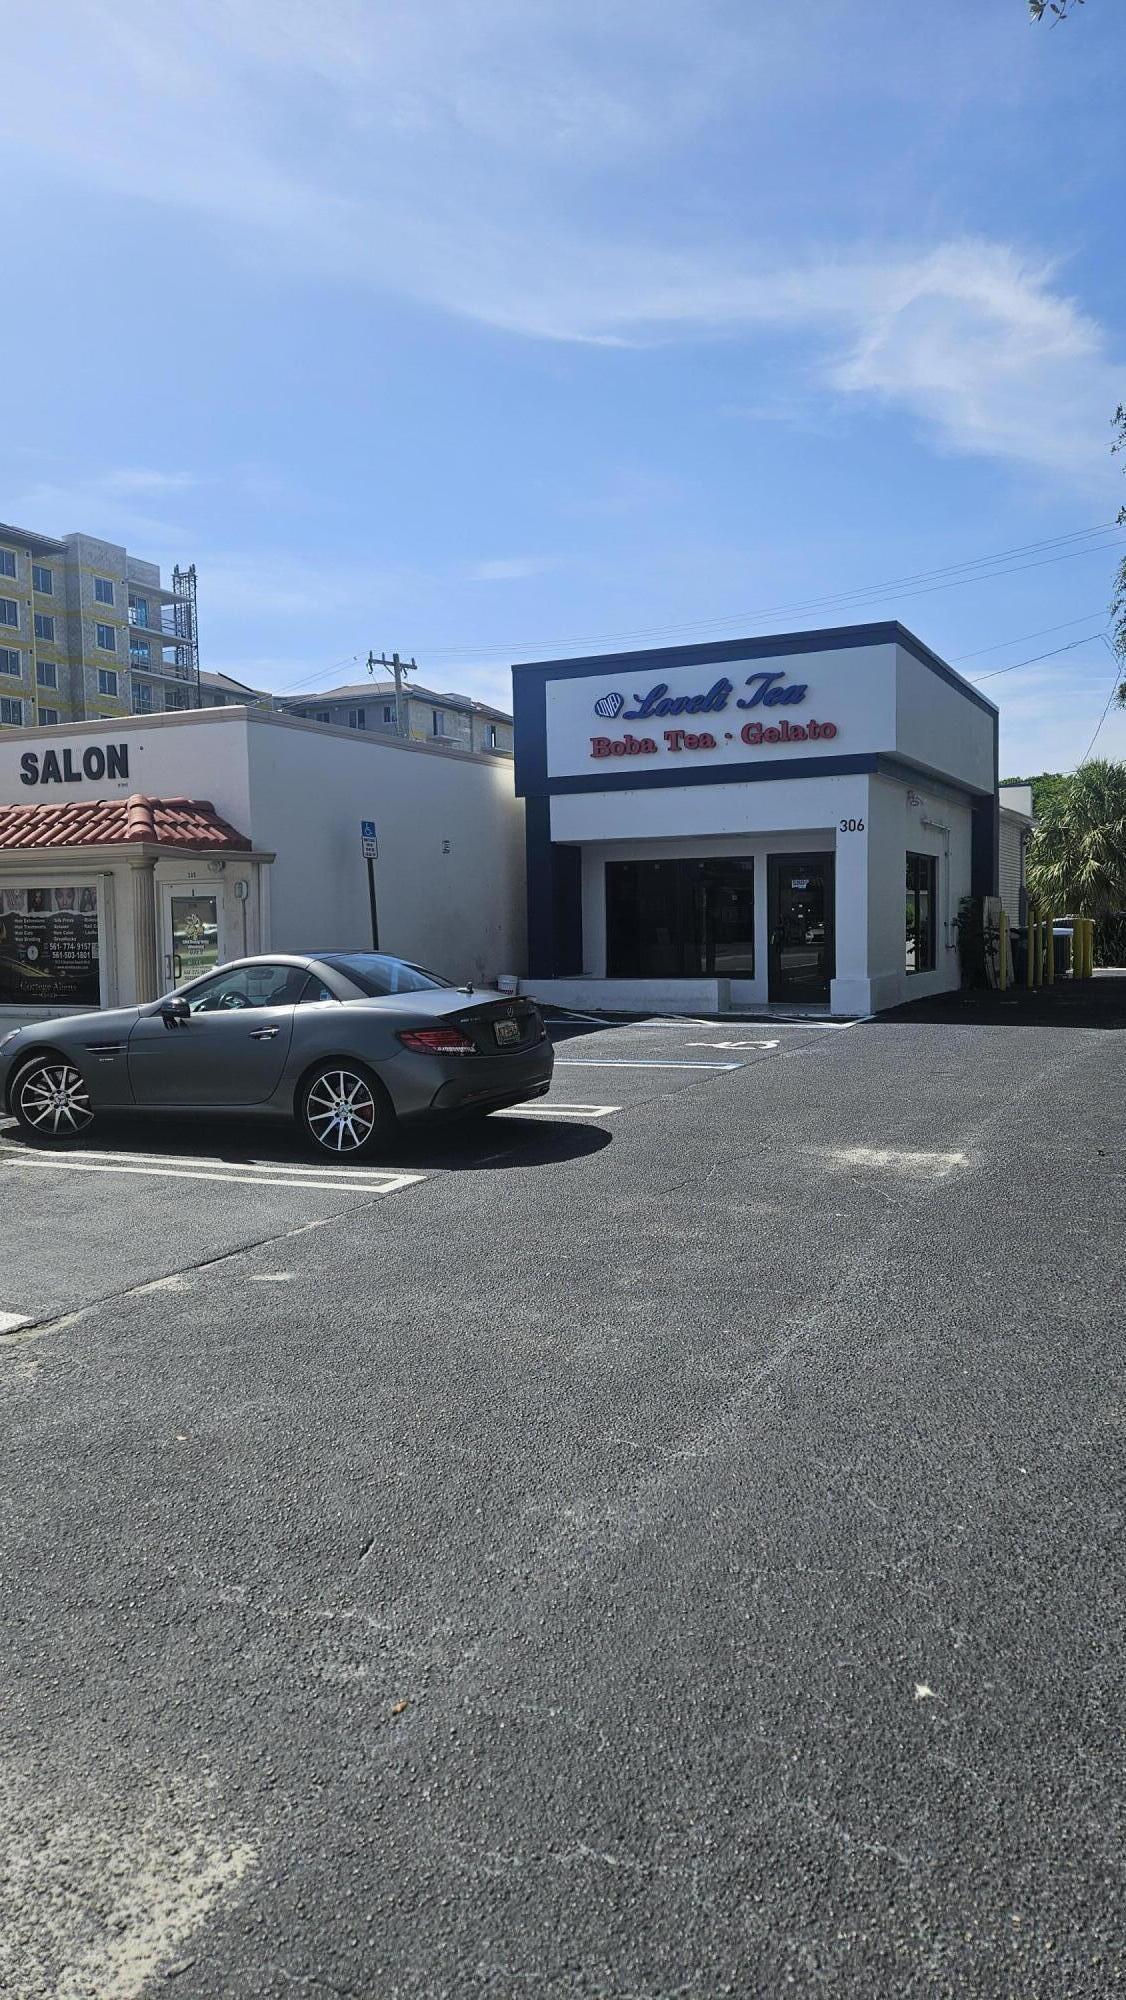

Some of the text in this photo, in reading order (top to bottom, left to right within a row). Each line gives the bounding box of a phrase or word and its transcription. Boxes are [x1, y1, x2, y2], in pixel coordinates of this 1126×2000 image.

[622, 671, 808, 720] Loveli Tea
[590, 734, 658, 758] Boba
[664, 729, 717, 752] Tea
[741, 719, 837, 745] Gelato
[20, 743, 129, 786] SALON
[839, 818, 865, 833] 306
